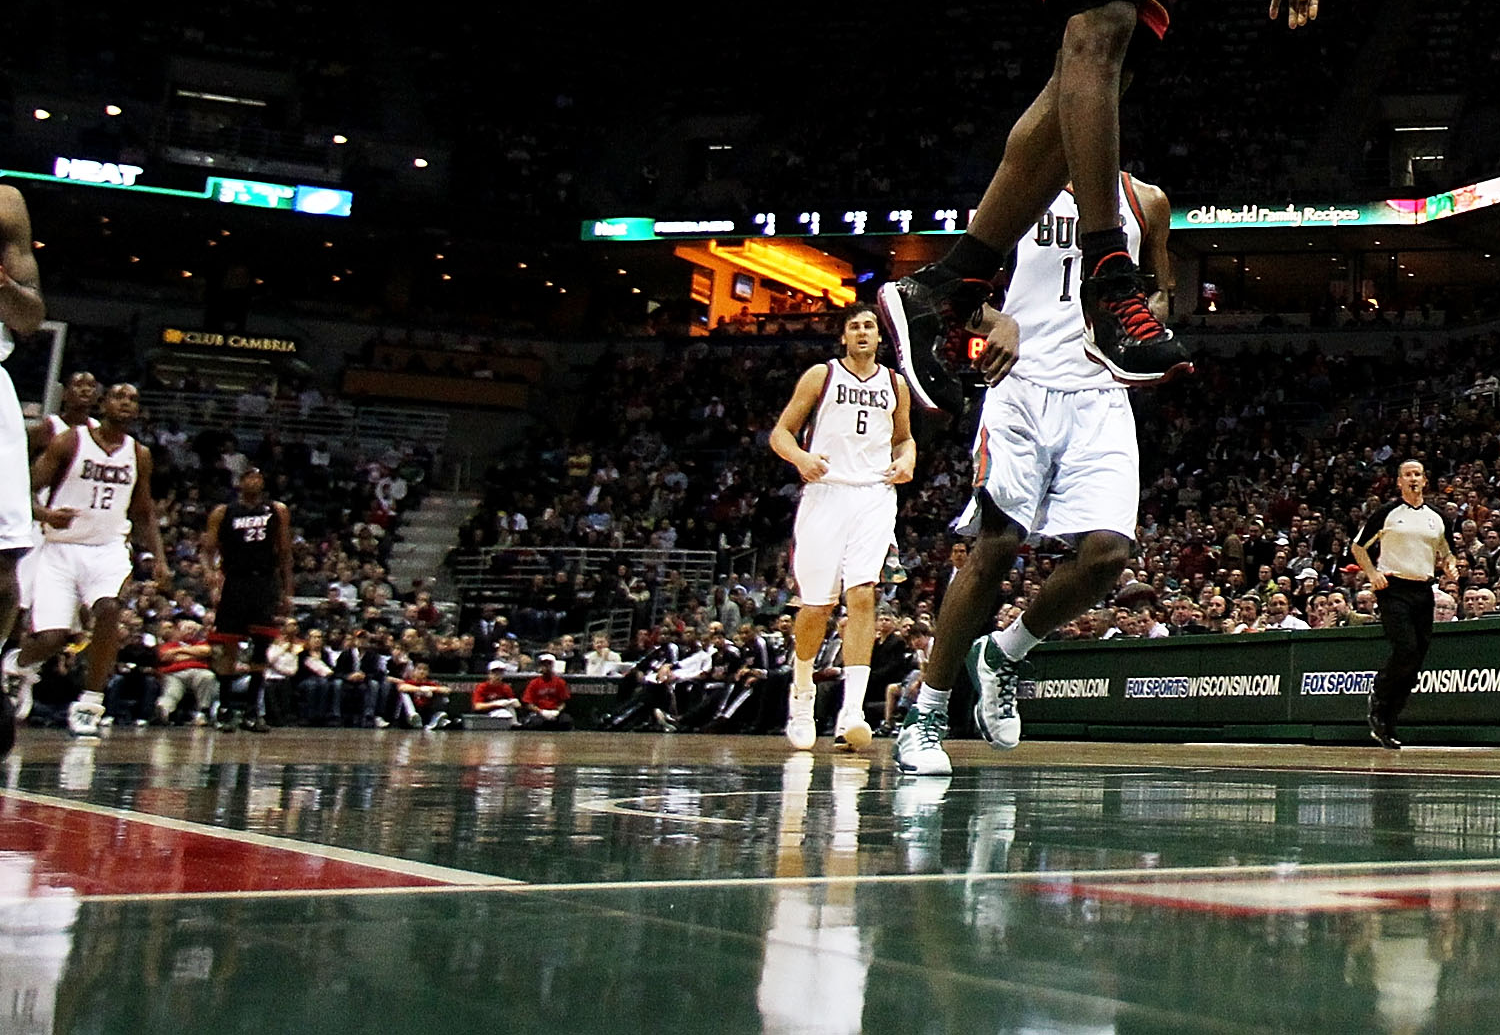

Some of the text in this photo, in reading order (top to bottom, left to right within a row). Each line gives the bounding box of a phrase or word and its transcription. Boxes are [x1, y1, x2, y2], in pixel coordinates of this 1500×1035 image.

[55, 157, 144, 187] HEAT
[1186, 204, 1360, 227] Old World Family Recipes
[184, 332, 297, 353] CLUB CAMBRIA
[836, 383, 889, 411] BUCKS
[856, 410, 869, 435] 6
[80, 458, 132, 486] BUCKS
[91, 486, 116, 511] 12
[232, 513, 272, 530] HEAT
[243, 527, 266, 543] 25
